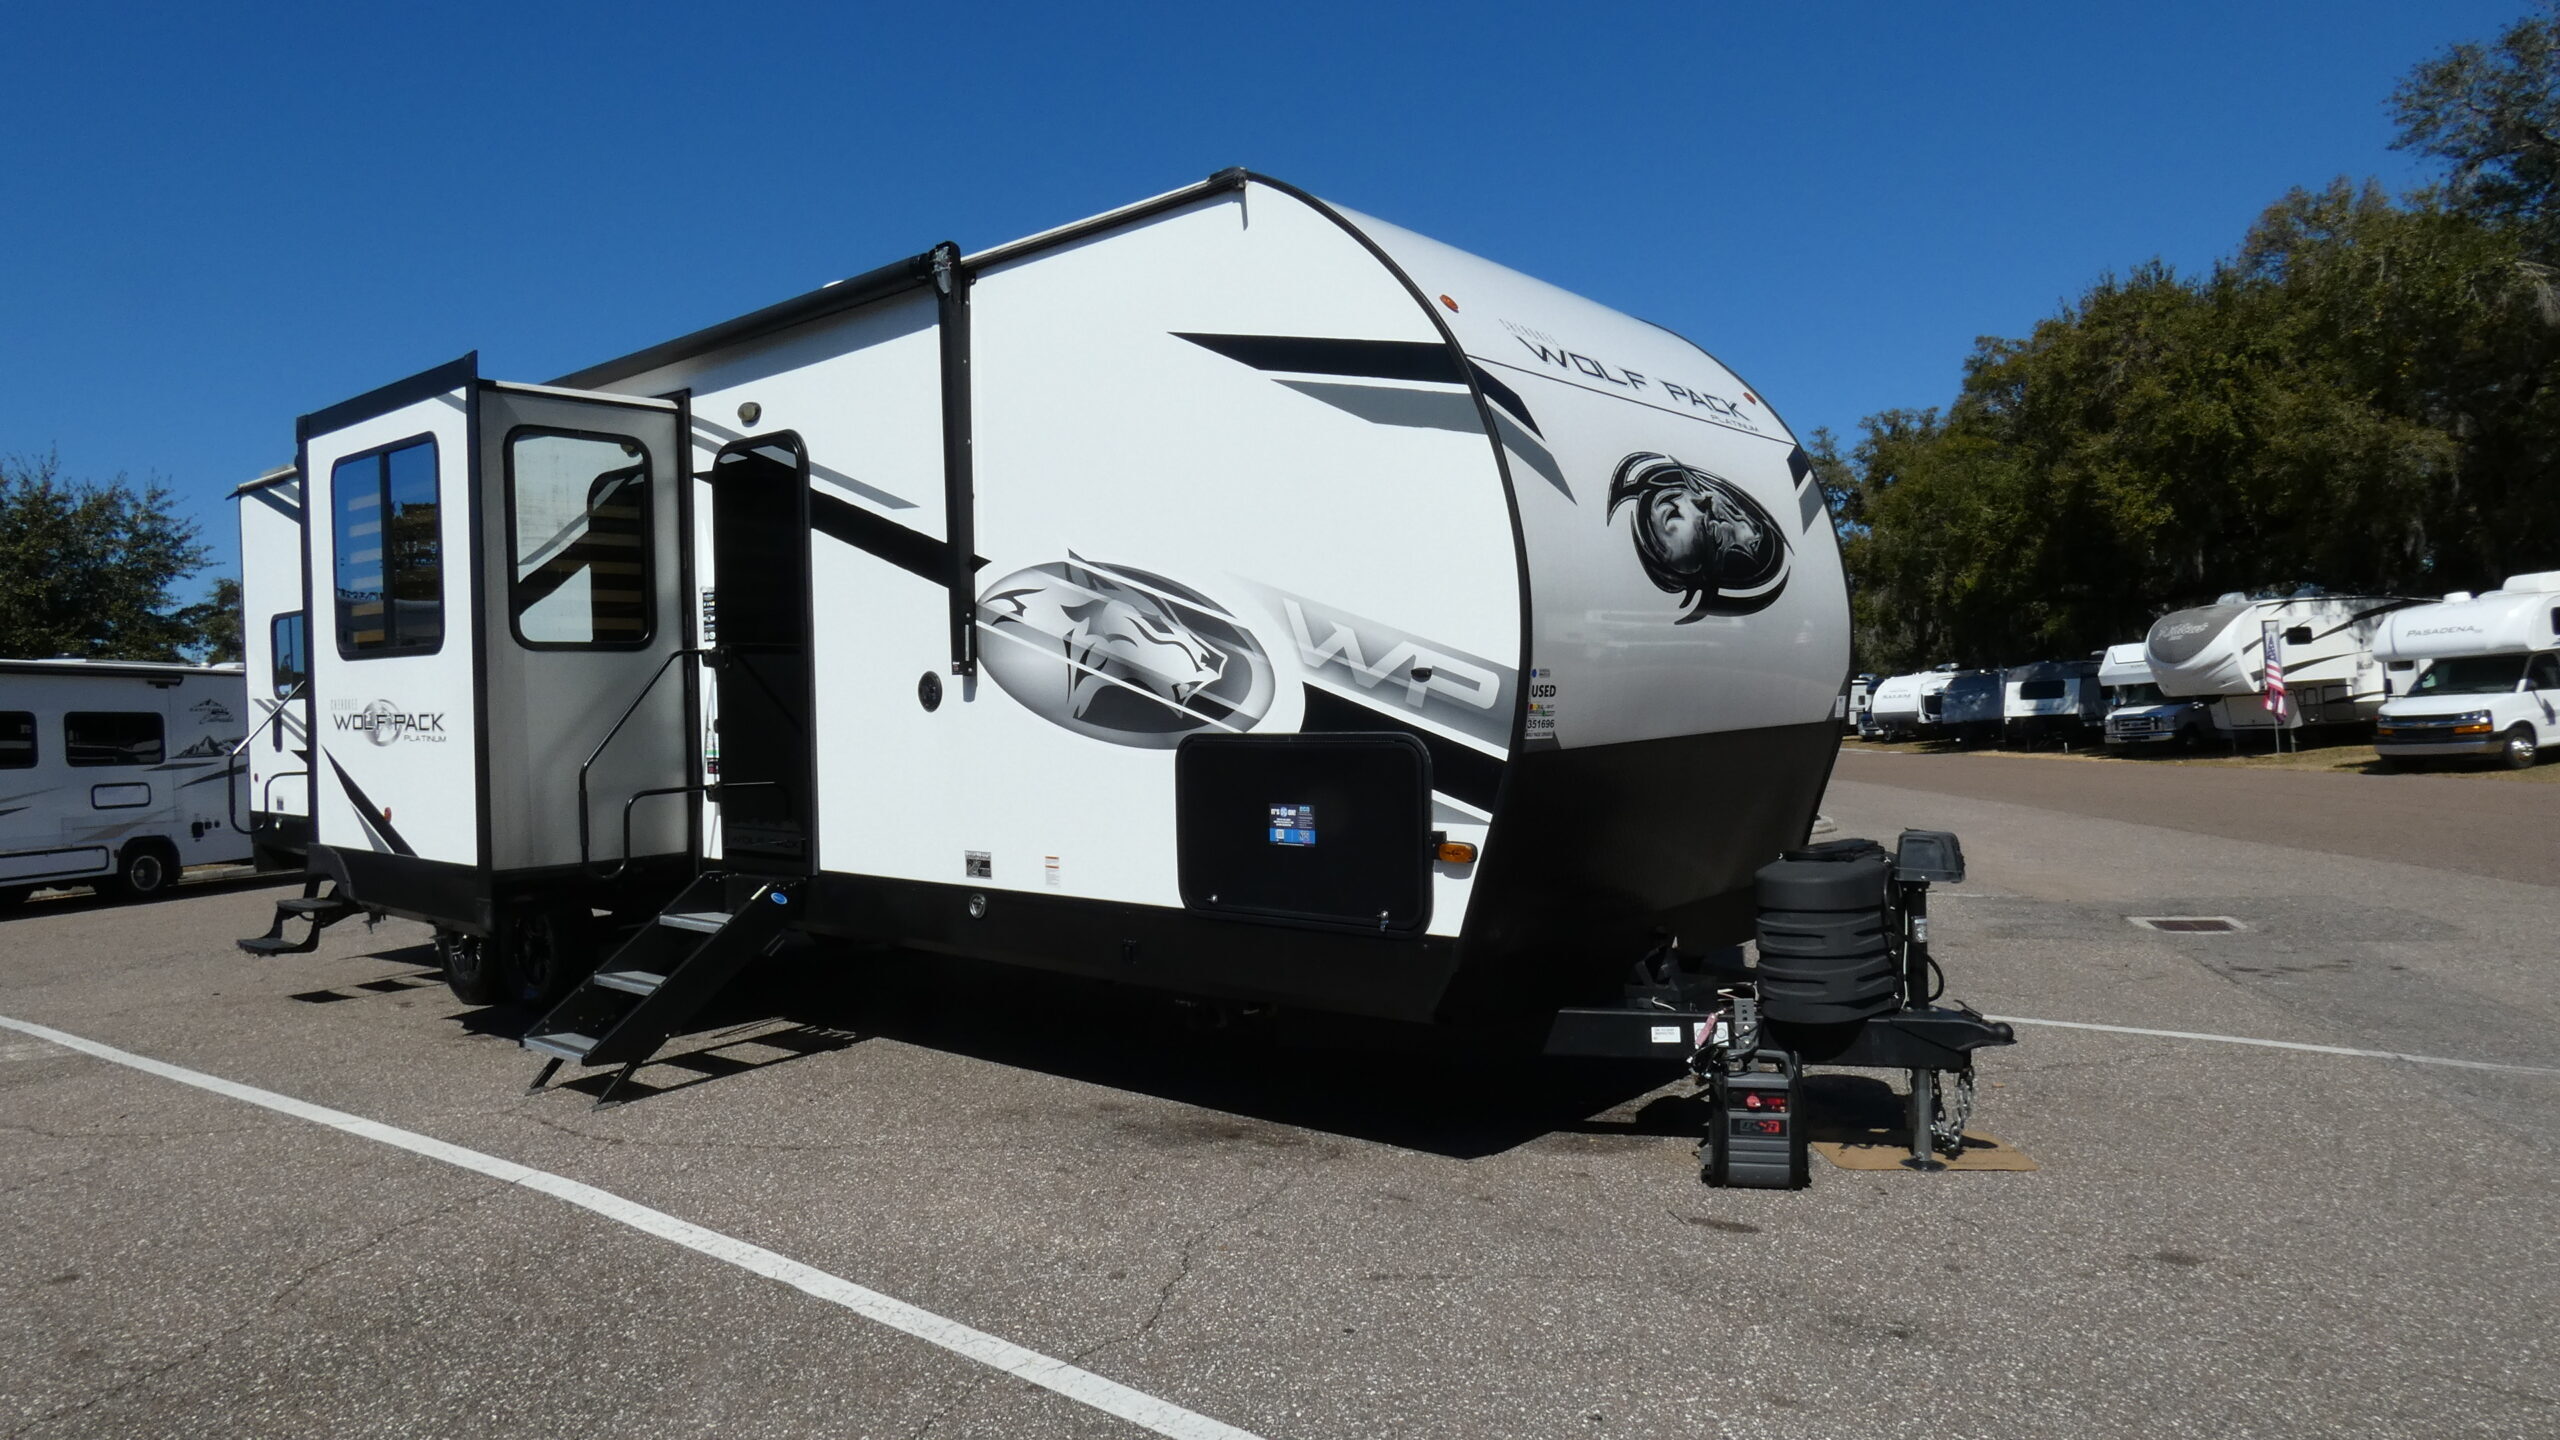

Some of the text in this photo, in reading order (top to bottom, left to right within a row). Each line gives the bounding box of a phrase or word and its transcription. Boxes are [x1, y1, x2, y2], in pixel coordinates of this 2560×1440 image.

[1515, 335, 1752, 422] WOLF PACK
[1711, 414, 1760, 433] PLATINUM
[2406, 625, 2475, 638] PASADENA
[1282, 597, 1501, 710] WP
[1531, 684, 1557, 698] USED
[333, 713, 446, 732] WOLF PACK
[1526, 719, 1555, 729] 351696
[403, 734, 447, 743] PLATINUM
